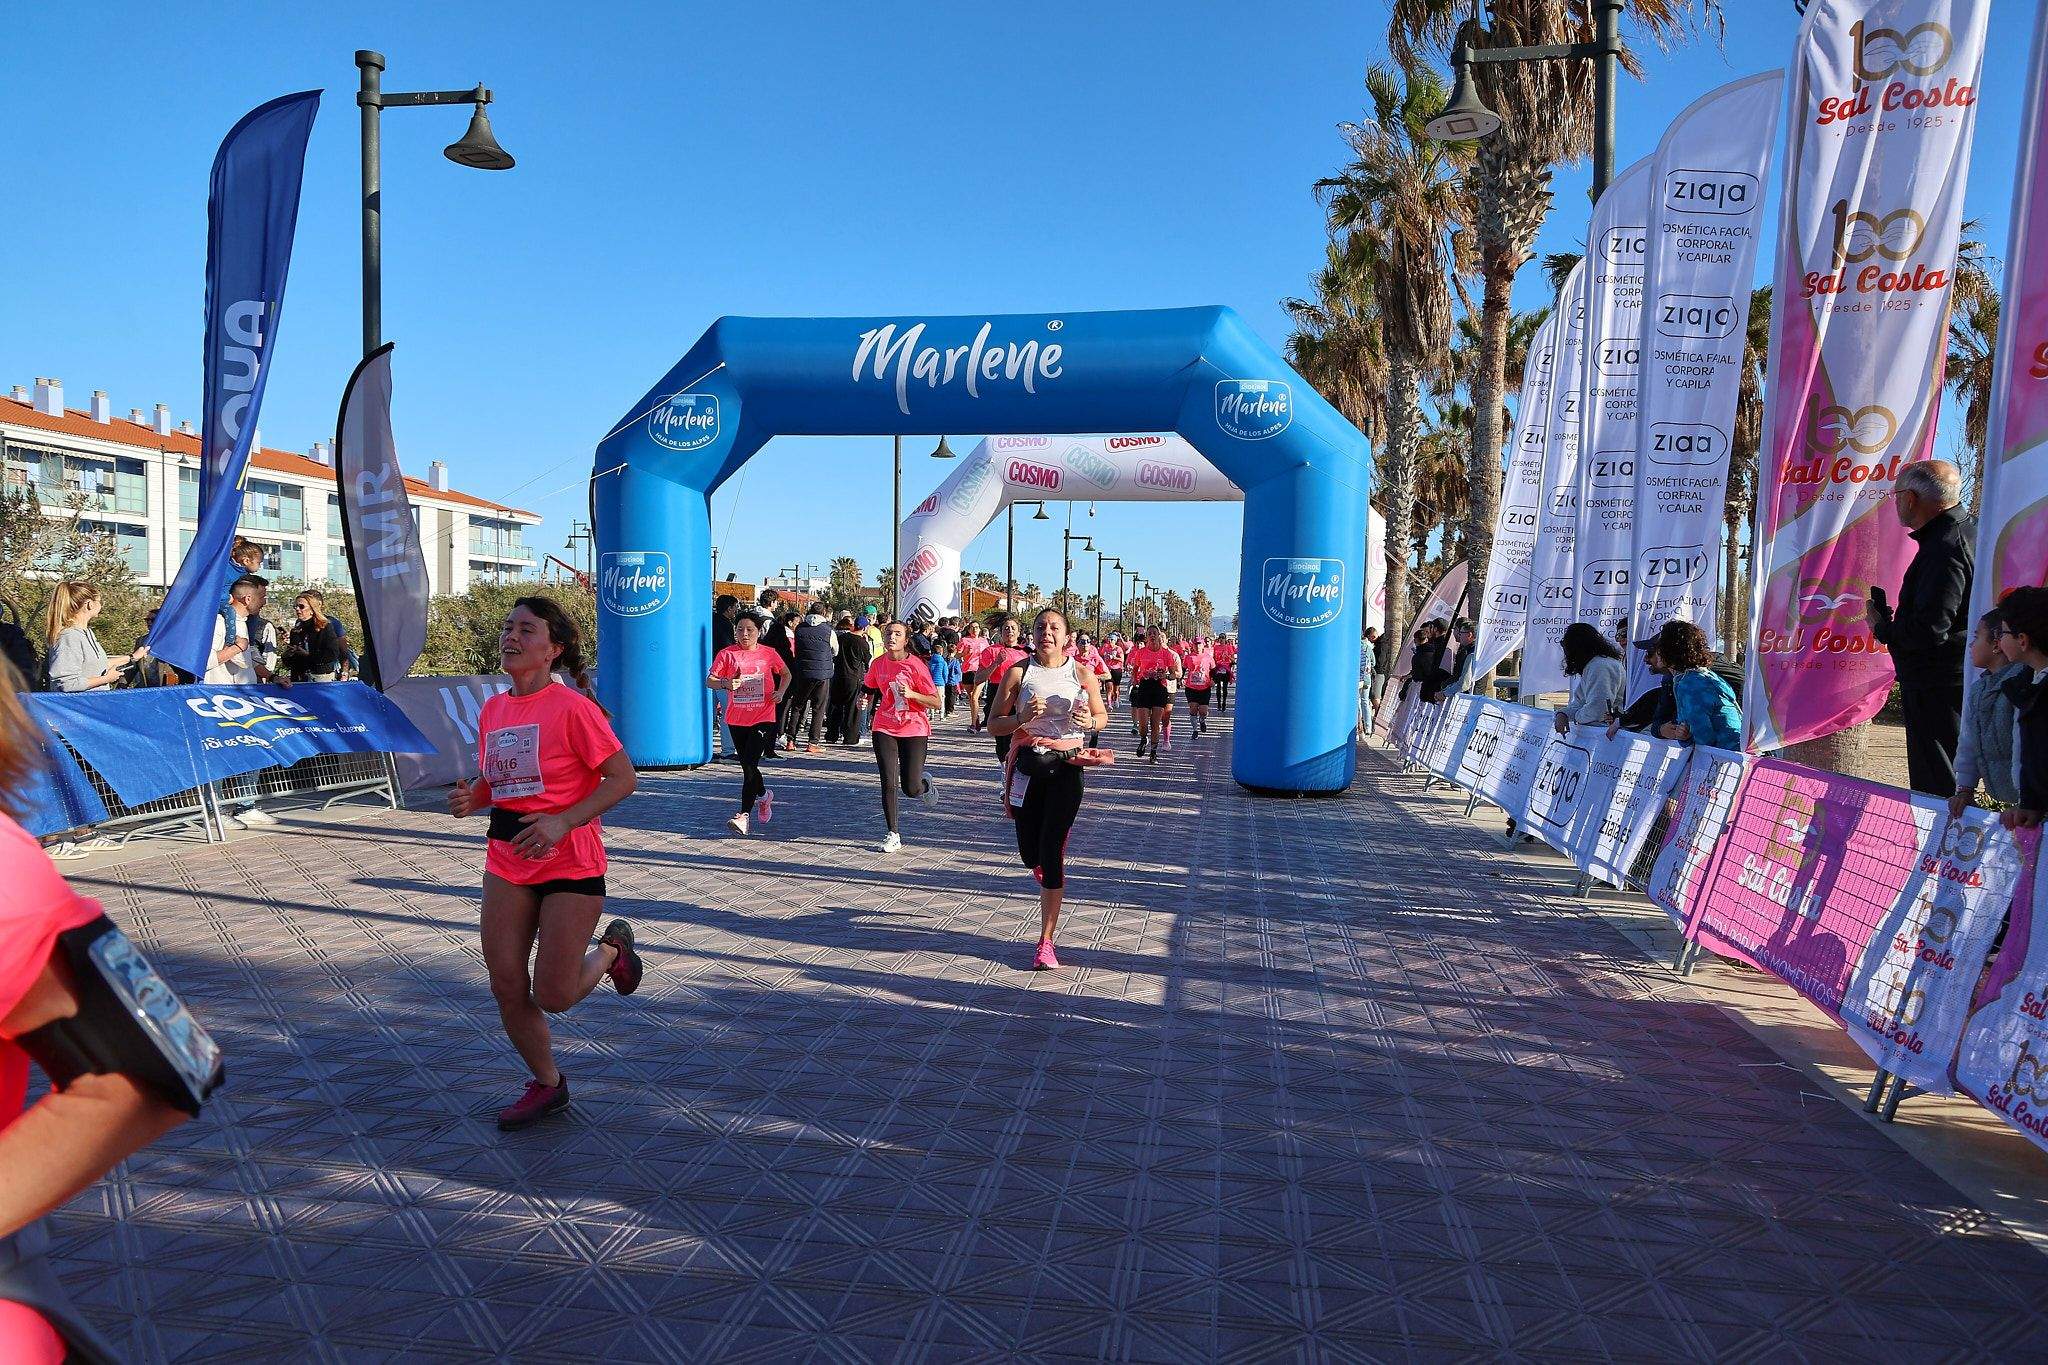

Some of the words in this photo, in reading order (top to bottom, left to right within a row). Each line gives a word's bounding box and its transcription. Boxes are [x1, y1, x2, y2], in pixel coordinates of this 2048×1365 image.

[1816, 86, 1871, 125] Sal
[1882, 78, 1976, 111] Costa
[1847, 121, 1895, 138] Desde
[1907, 116, 1943, 129] 1925
[1673, 181, 1746, 208] ziaja
[1663, 223, 1717, 236] OSMÉTICA
[1676, 238, 1735, 250] CORPORAL
[1677, 252, 1684, 261] Y
[1686, 252, 1731, 263] CAPILAR
[1801, 266, 1847, 299] Sal
[1856, 264, 1949, 294] Costa
[1826, 302, 1871, 313] Desde
[1882, 300, 1912, 311] 1925
[1655, 350, 1704, 363] OSMÉTICA
[1665, 365, 1715, 376] CORPORA
[1666, 379, 1673, 387] Y
[1675, 379, 1711, 390] CAPILA
[1224, 422, 1238, 434] HIJA
[1262, 422, 1283, 436] ALPES
[655, 432, 668, 444] HIJA
[691, 434, 711, 447] ALPES
[1109, 437, 1161, 449] COSMO
[1008, 461, 1059, 489] COSMO
[1140, 463, 1192, 490] COSMO
[1854, 490, 1887, 501] 1925
[1658, 504, 1664, 513] Y
[356, 462, 410, 580] IMR
[640, 598, 661, 612] ALPES
[1269, 606, 1284, 619] HIJA
[1312, 610, 1333, 624] ALPES
[1759, 628, 1805, 654] Sal
[1832, 660, 1867, 671] 1925
[1539, 761, 1581, 813] ziaja
[1738, 854, 1773, 893] Sal
[1771, 955, 1832, 1006] MOMENTOS
[1986, 1084, 2011, 1114] Sal
